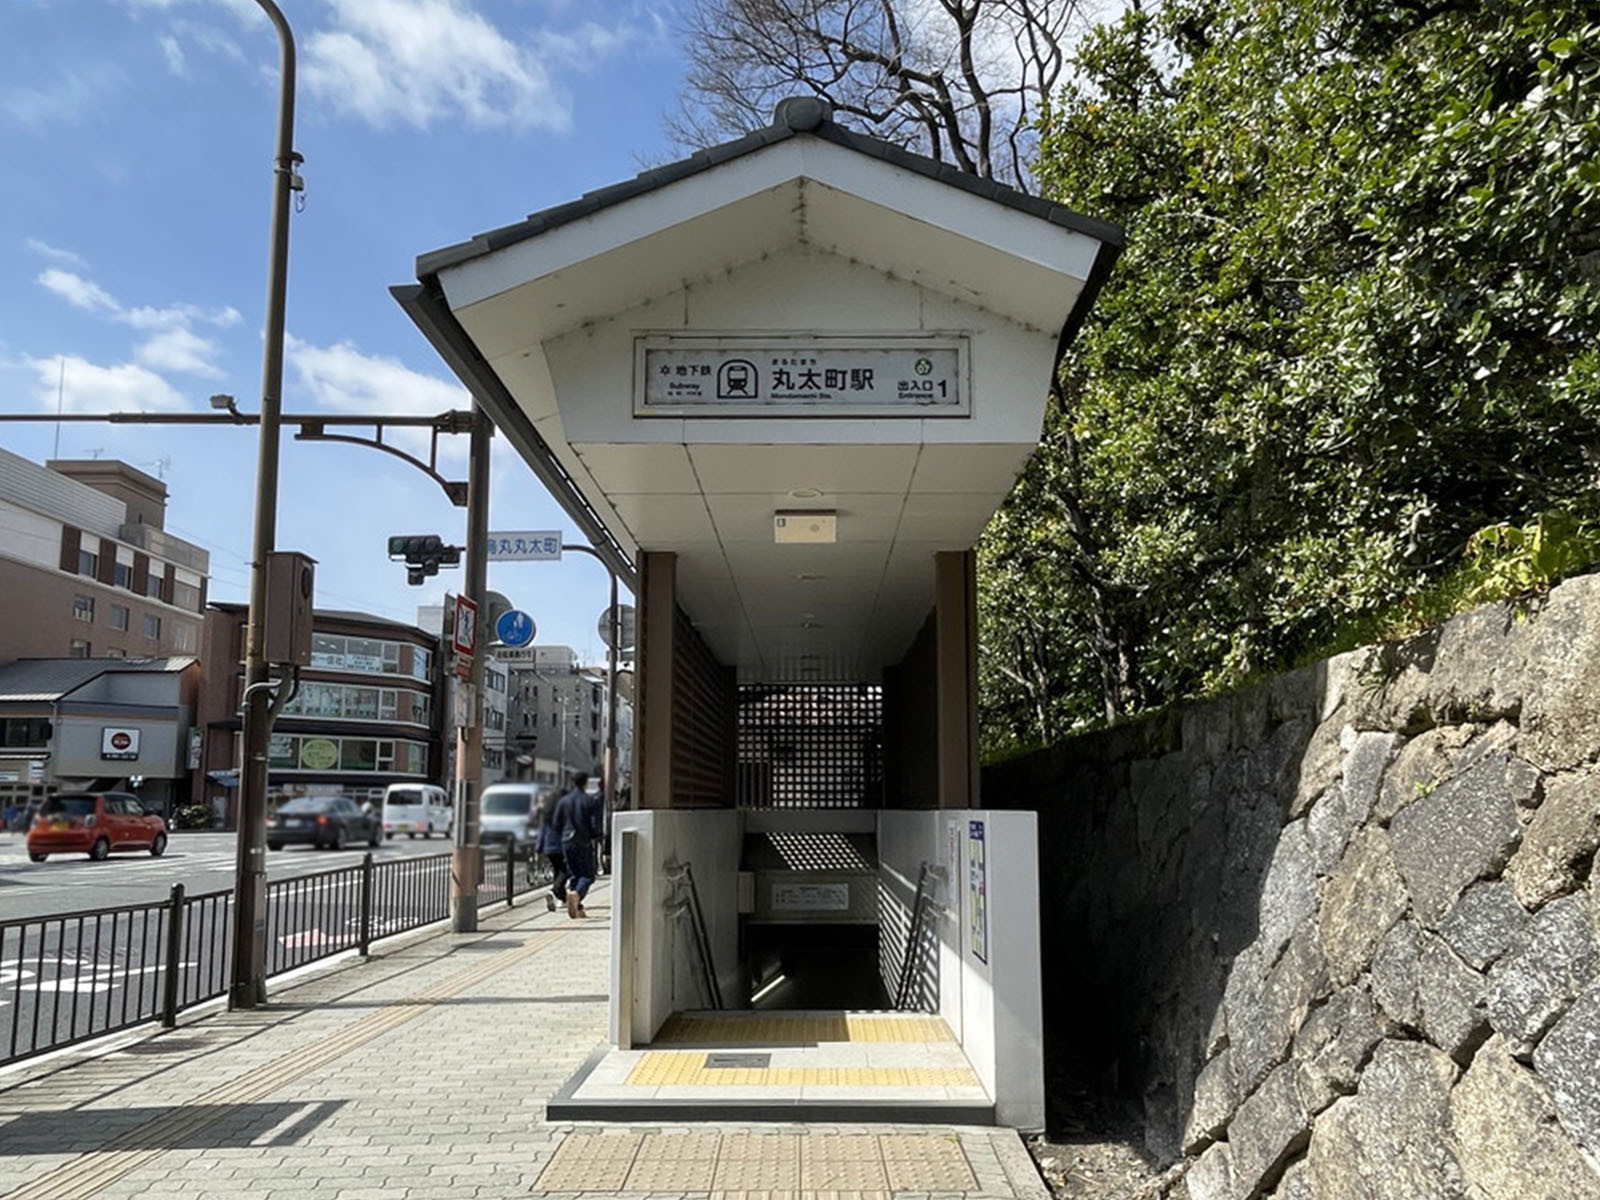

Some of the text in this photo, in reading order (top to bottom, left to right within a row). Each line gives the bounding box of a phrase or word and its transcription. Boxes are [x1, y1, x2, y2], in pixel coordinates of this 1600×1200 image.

[675, 365, 711, 376] 地下鉄
[669, 382, 700, 391] Subway
[771, 368, 875, 391] 丸太町駅
[897, 379, 947, 398] 出入口 1
